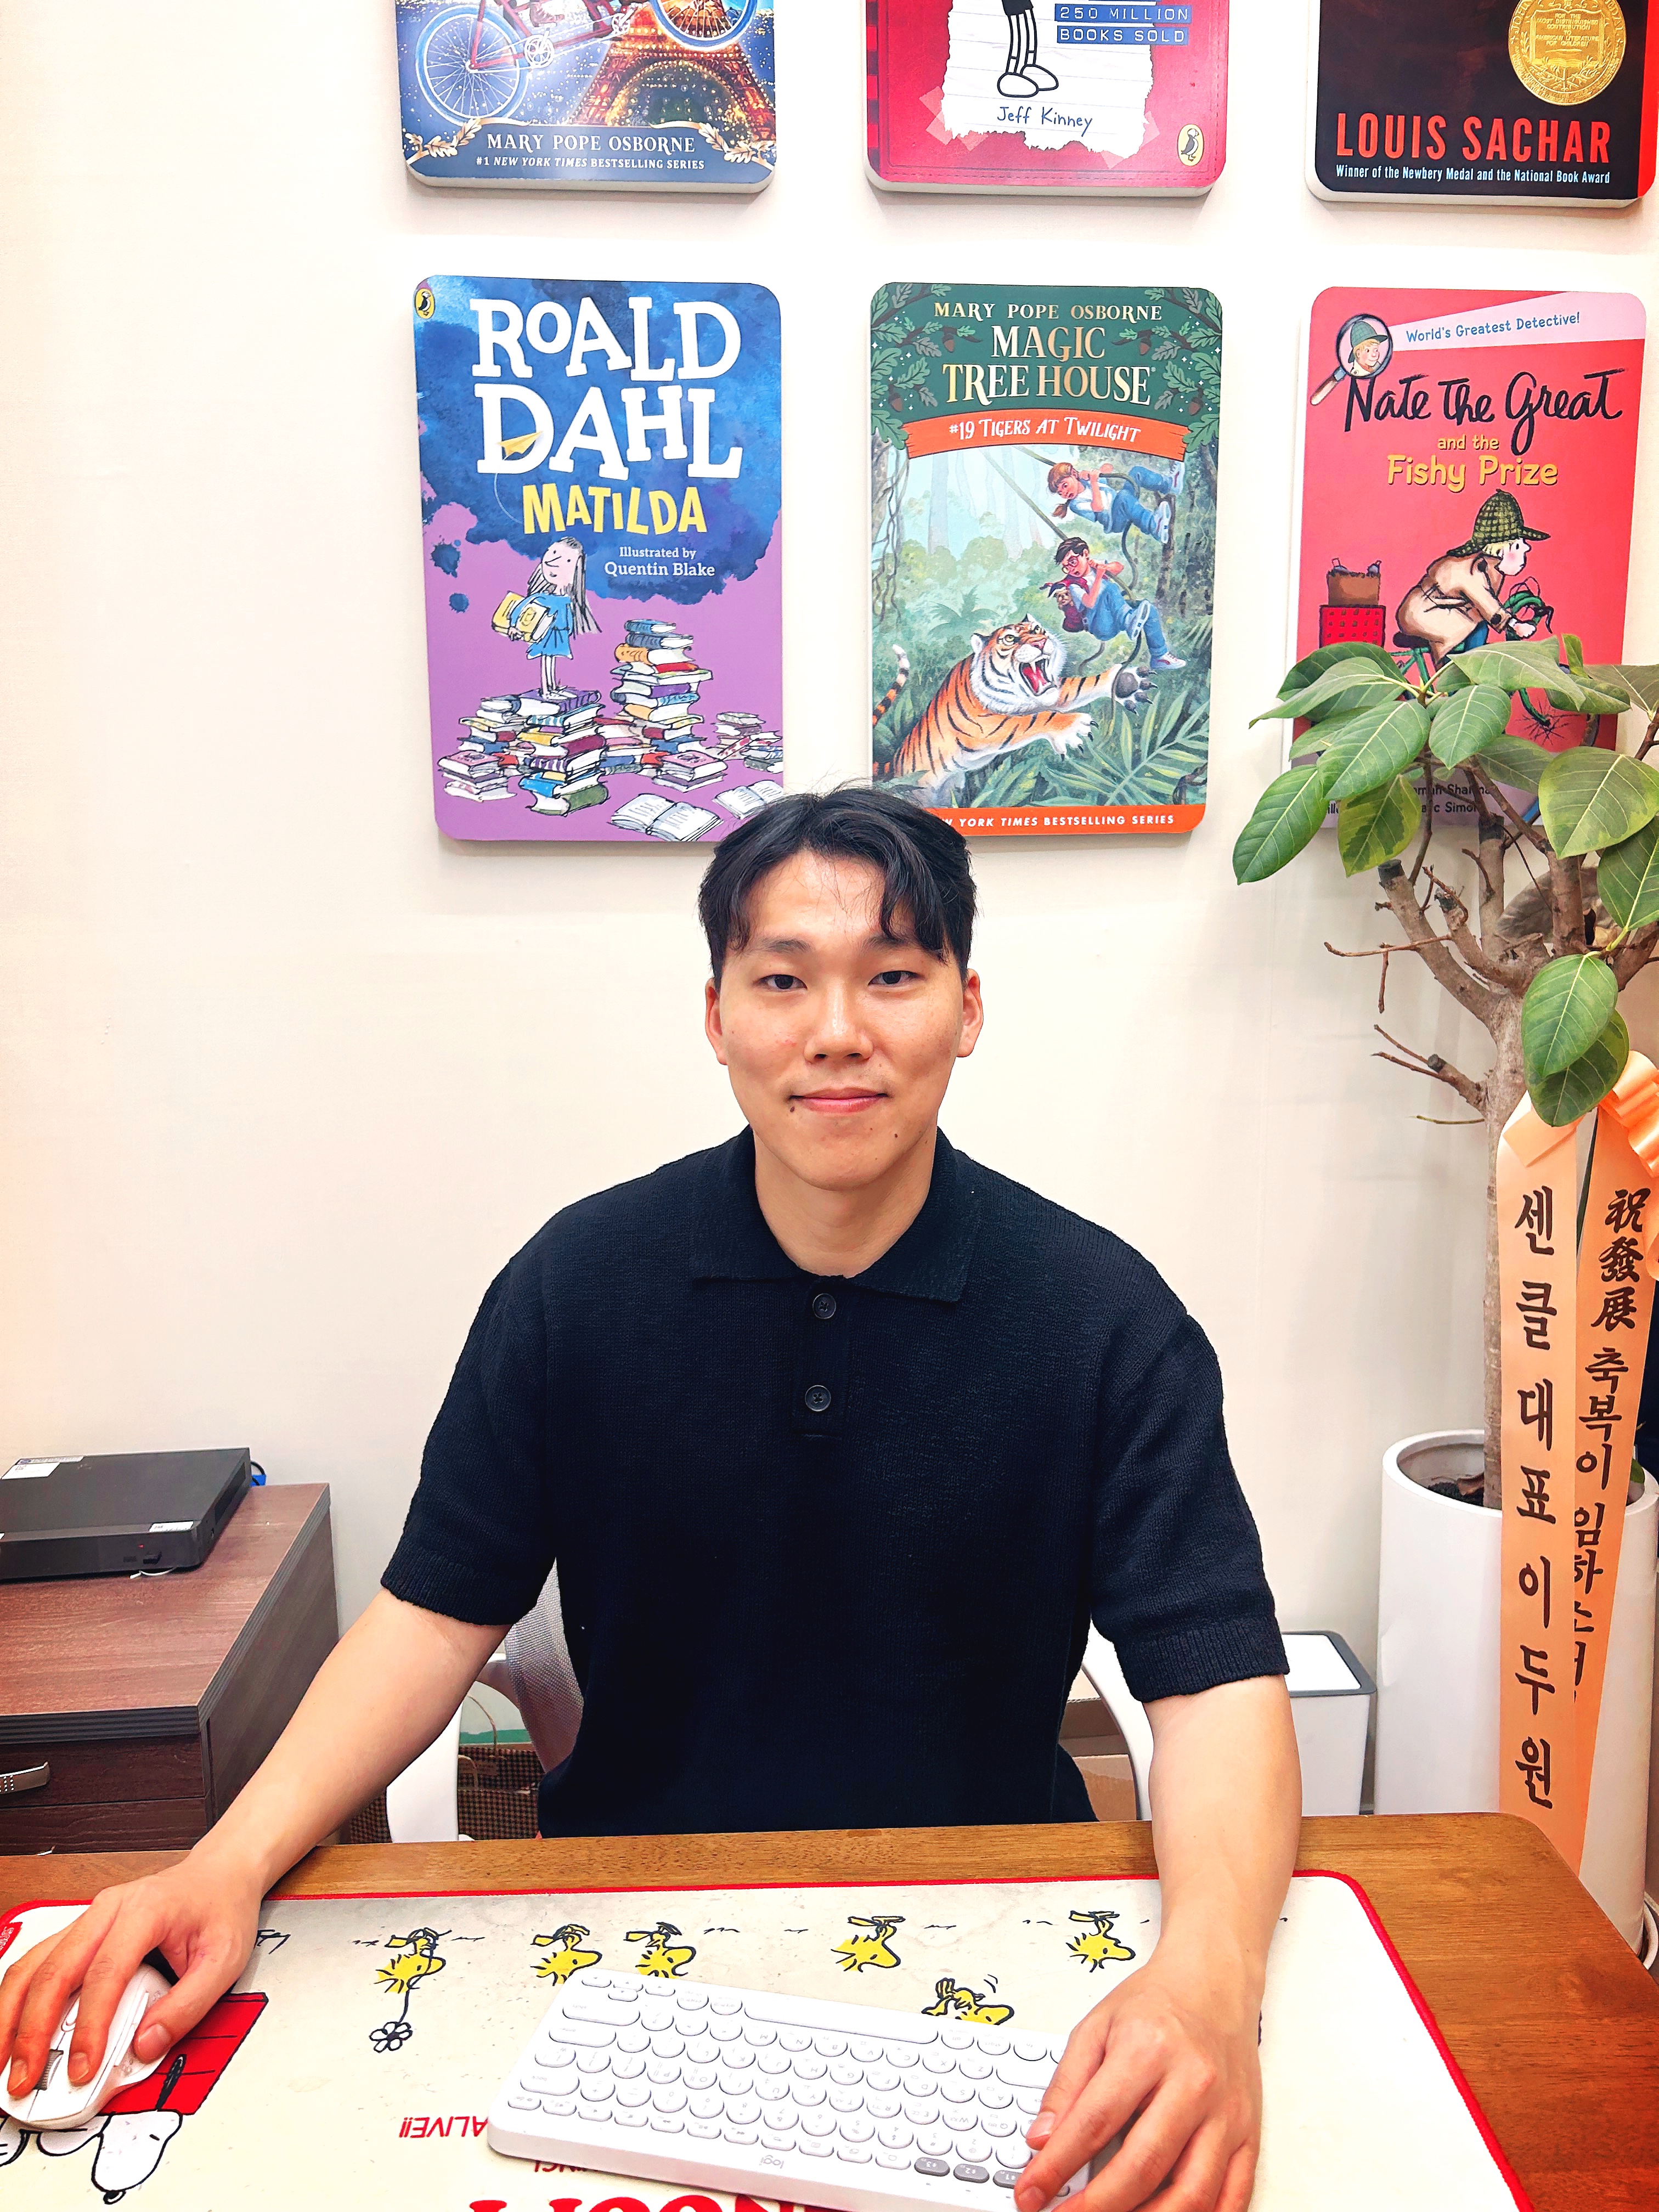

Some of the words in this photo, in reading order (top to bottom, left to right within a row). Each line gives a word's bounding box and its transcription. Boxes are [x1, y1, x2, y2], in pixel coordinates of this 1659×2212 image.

[1060, 7, 1097, 19] 250
[1110, 8, 1188, 20] MILLION
[1060, 29, 1123, 41] BOOKS
[1135, 30, 1184, 43] SOLD
[997, 106, 1031, 123] Jeff
[1042, 107, 1092, 137] Kinney
[488, 134, 543, 153] MARY
[554, 136, 601, 150] POPE
[609, 137, 695, 155] OSBORNE
[1337, 113, 1446, 160] LOUIS
[1463, 117, 1610, 162] SACHAR
[477, 157, 489, 165] #1
[494, 157, 518, 166] NEW
[522, 157, 550, 166] YORK
[555, 158, 587, 167] TIMES
[591, 158, 663, 169] BESTSELLING
[667, 160, 704, 169] SERIES
[1336, 165, 1369, 177] Winner
[1373, 166, 1381, 178] of
[1385, 166, 1399, 178] the
[1403, 167, 1442, 182] Newbery
[1446, 168, 1473, 180] Medal
[1477, 169, 1493, 180] and
[1497, 169, 1510, 180] the
[1515, 170, 1553, 182] National
[1557, 171, 1578, 182] Book
[1582, 172, 1610, 183] Award
[935, 303, 995, 321] MARY
[1008, 304, 1058, 319] POPE
[1071, 306, 1161, 323] OSBORNE
[470, 296, 741, 381] ROALD
[1407, 326, 1451, 342] World's
[1456, 320, 1511, 337] Greatest
[1517, 312, 1579, 330] Detective!
[991, 326, 1105, 362] MAGIC
[943, 364, 1029, 405] TREE
[1037, 366, 1150, 405] HOUSE
[1345, 374, 1431, 432] Nate
[1506, 368, 1629, 455] Great
[474, 383, 743, 480] DAHL
[949, 421, 974, 439] #19
[979, 417, 1030, 437] TIGERS
[1036, 419, 1059, 435] AT
[1064, 417, 1141, 442] TWILIGHT
[1438, 436, 1466, 450] and
[1472, 434, 1499, 450] the
[1387, 455, 1466, 493] Fishy
[1479, 456, 1559, 486] Prize
[522, 484, 707, 535] MATILDA
[620, 546, 679, 557] Illustrated
[682, 548, 696, 559] by
[605, 562, 668, 577] Quentin
[673, 563, 714, 575] Blake
[960, 816, 994, 827] YORK
[1001, 817, 1037, 826] TIMES
[1045, 816, 1125, 825] BESTSELLING
[1132, 815, 1173, 824] SERIES
[1576, 1347, 1629, 1490] 축복이
[399, 2116, 488, 2138] ALIVE!!
[759, 2155, 784, 2169] logi
